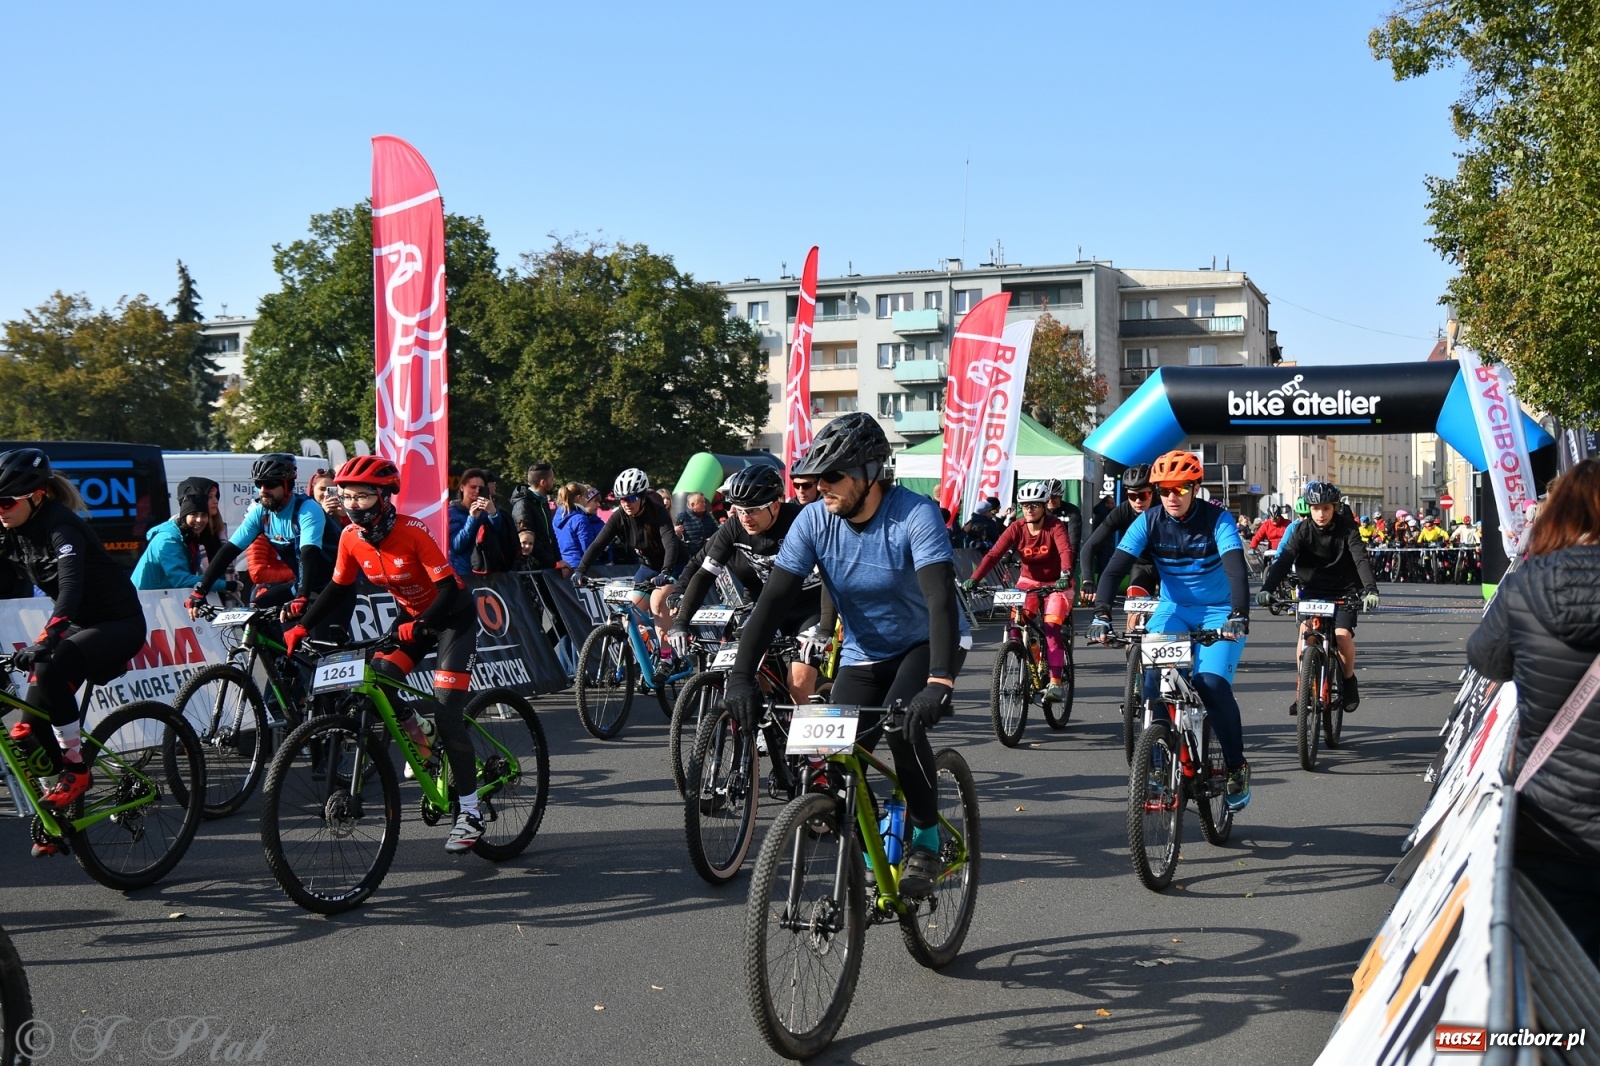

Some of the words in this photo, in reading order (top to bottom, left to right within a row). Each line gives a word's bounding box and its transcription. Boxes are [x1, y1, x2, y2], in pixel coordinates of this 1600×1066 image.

[1228, 390, 1285, 416] bike
[1292, 389, 1381, 416] atelier
[221, 613, 247, 621] 3007
[698, 612, 725, 620] 2252
[720, 652, 738, 663] 29
[1151, 646, 1183, 659] 3035
[322, 665, 355, 681] 1261
[434, 673, 456, 683] Nice
[128, 673, 175, 702] MORE
[802, 723, 845, 739] 3091
